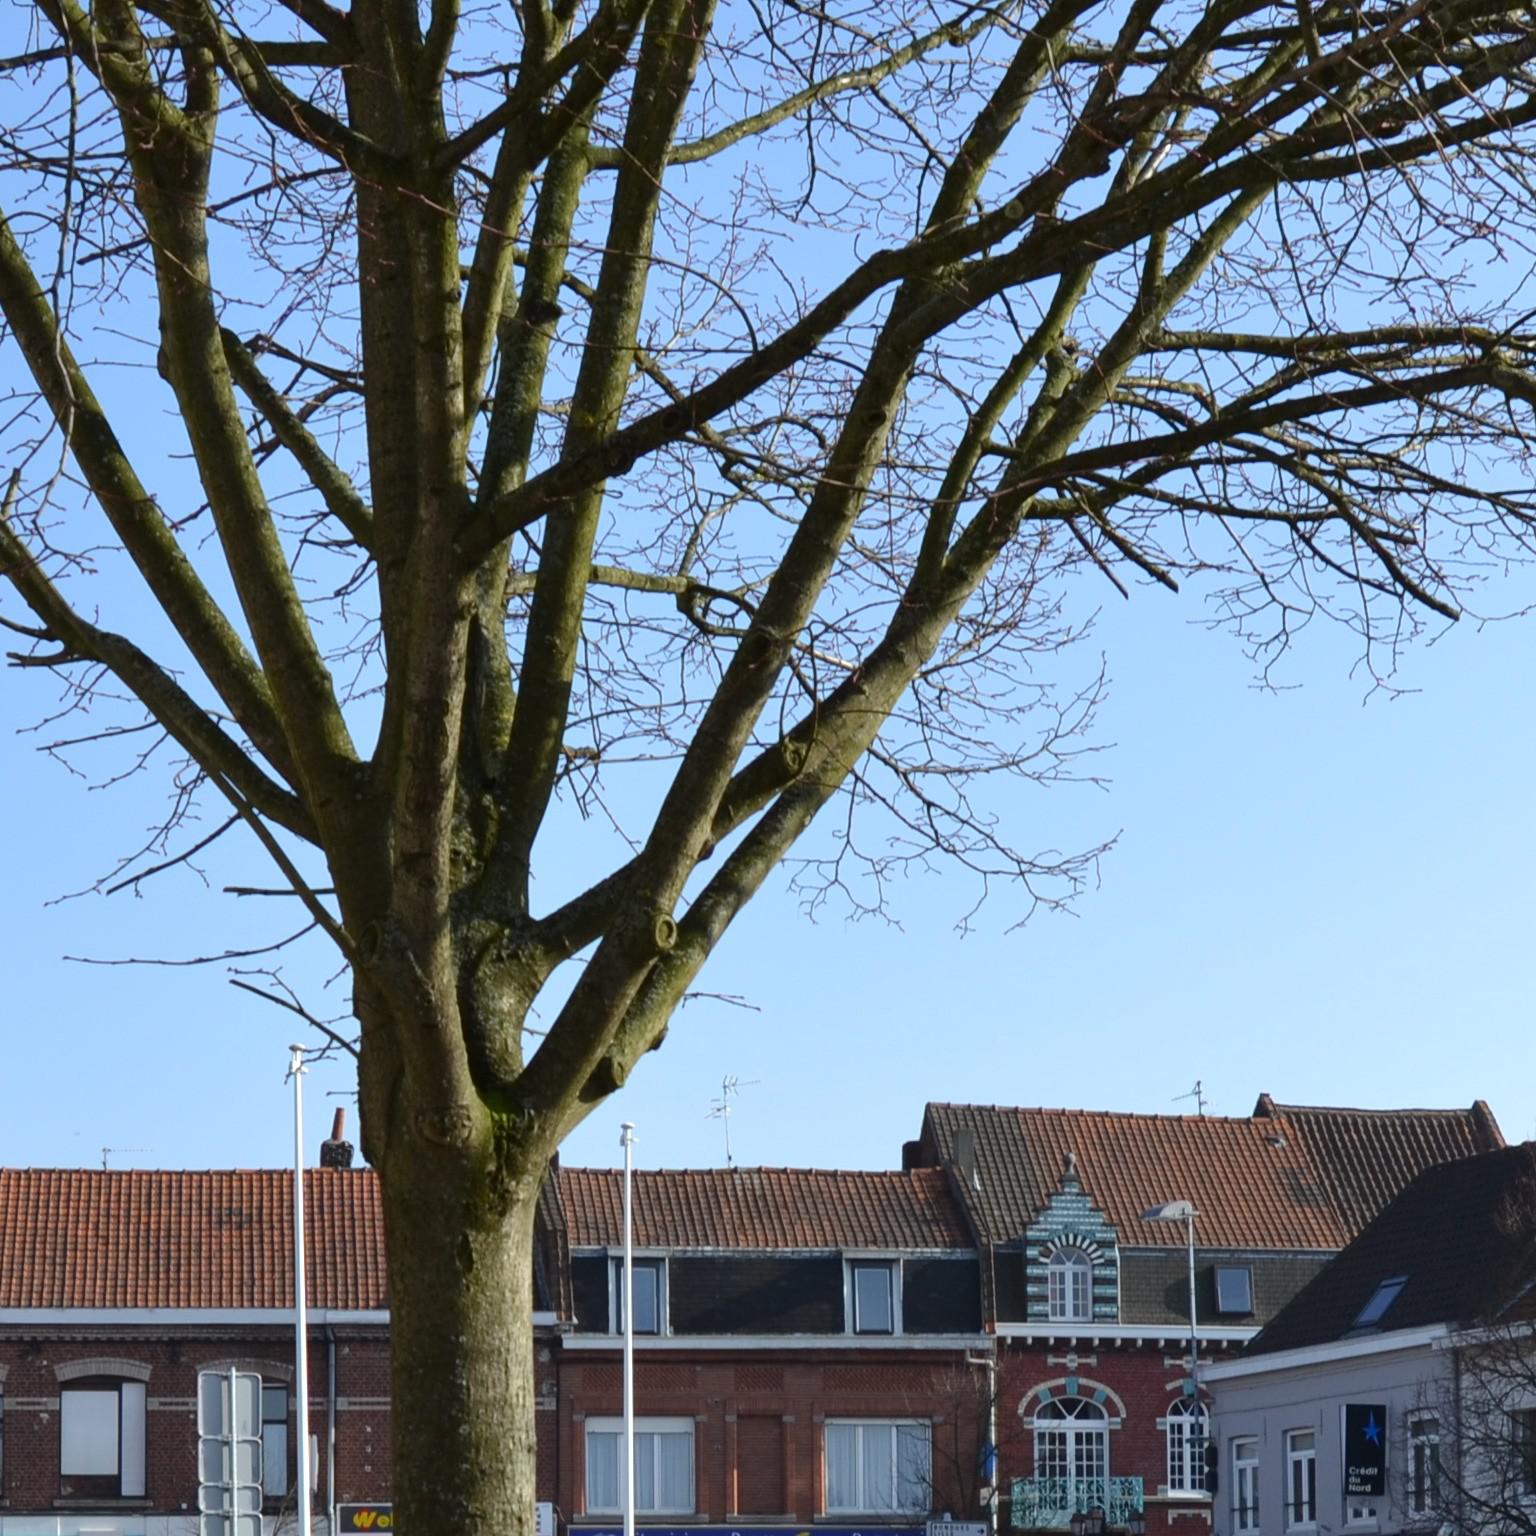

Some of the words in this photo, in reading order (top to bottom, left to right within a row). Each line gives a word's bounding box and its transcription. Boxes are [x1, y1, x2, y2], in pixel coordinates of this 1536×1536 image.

[1348, 1466, 1378, 1475] Crédit
[1348, 1475, 1361, 1484] du
[1348, 1484, 1372, 1493] Nord
